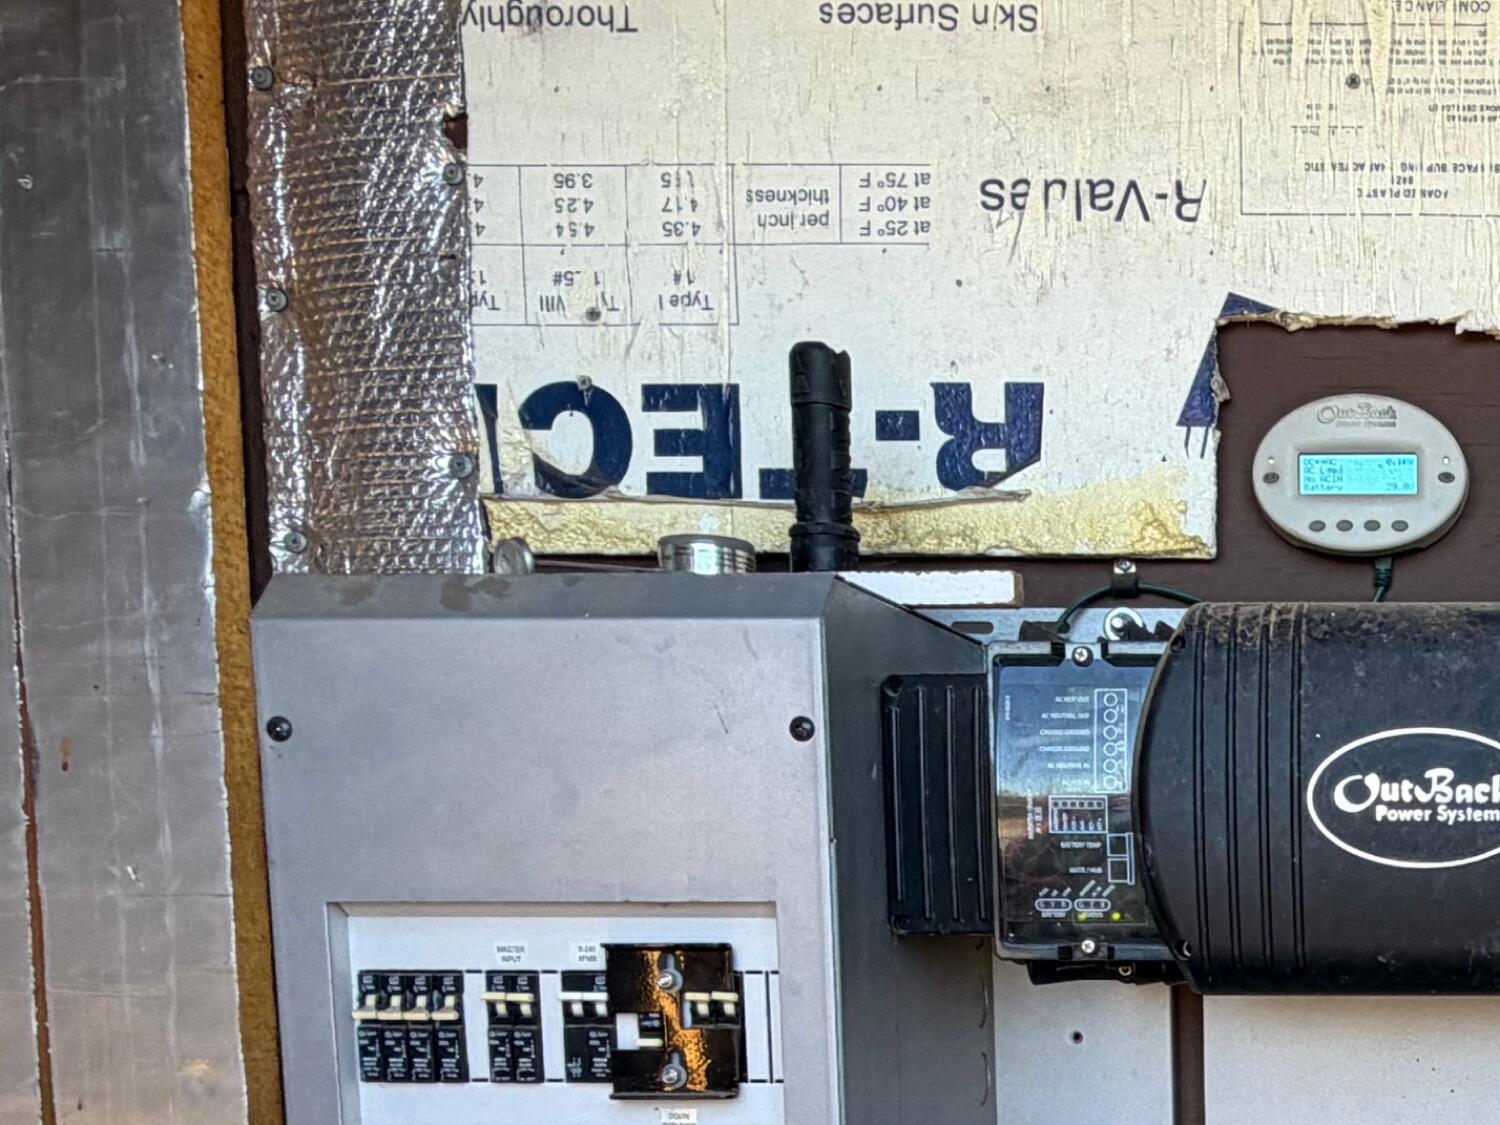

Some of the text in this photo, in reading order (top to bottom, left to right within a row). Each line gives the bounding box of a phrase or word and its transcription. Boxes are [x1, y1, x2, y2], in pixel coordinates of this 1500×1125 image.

[461, 0, 638, 33] Thoroughly
[819, 2, 1039, 32] Skin Surfaces
[553, 172, 593, 189] 3.95
[858, 172, 872, 188] F
[914, 172, 931, 185] at
[555, 197, 594, 214] 4.25
[746, 188, 830, 206] thickness
[858, 196, 872, 212] F
[914, 196, 931, 209] at
[979, 178, 1207, 222] R-Values
[757, 210, 830, 228] per inch
[914, 220, 931, 233] at
[555, 221, 595, 238] 4.54
[662, 221, 702, 238] 4.35
[858, 220, 872, 236] F
[668, 292, 714, 311] Type
[1376, 805, 1431, 822] Power
